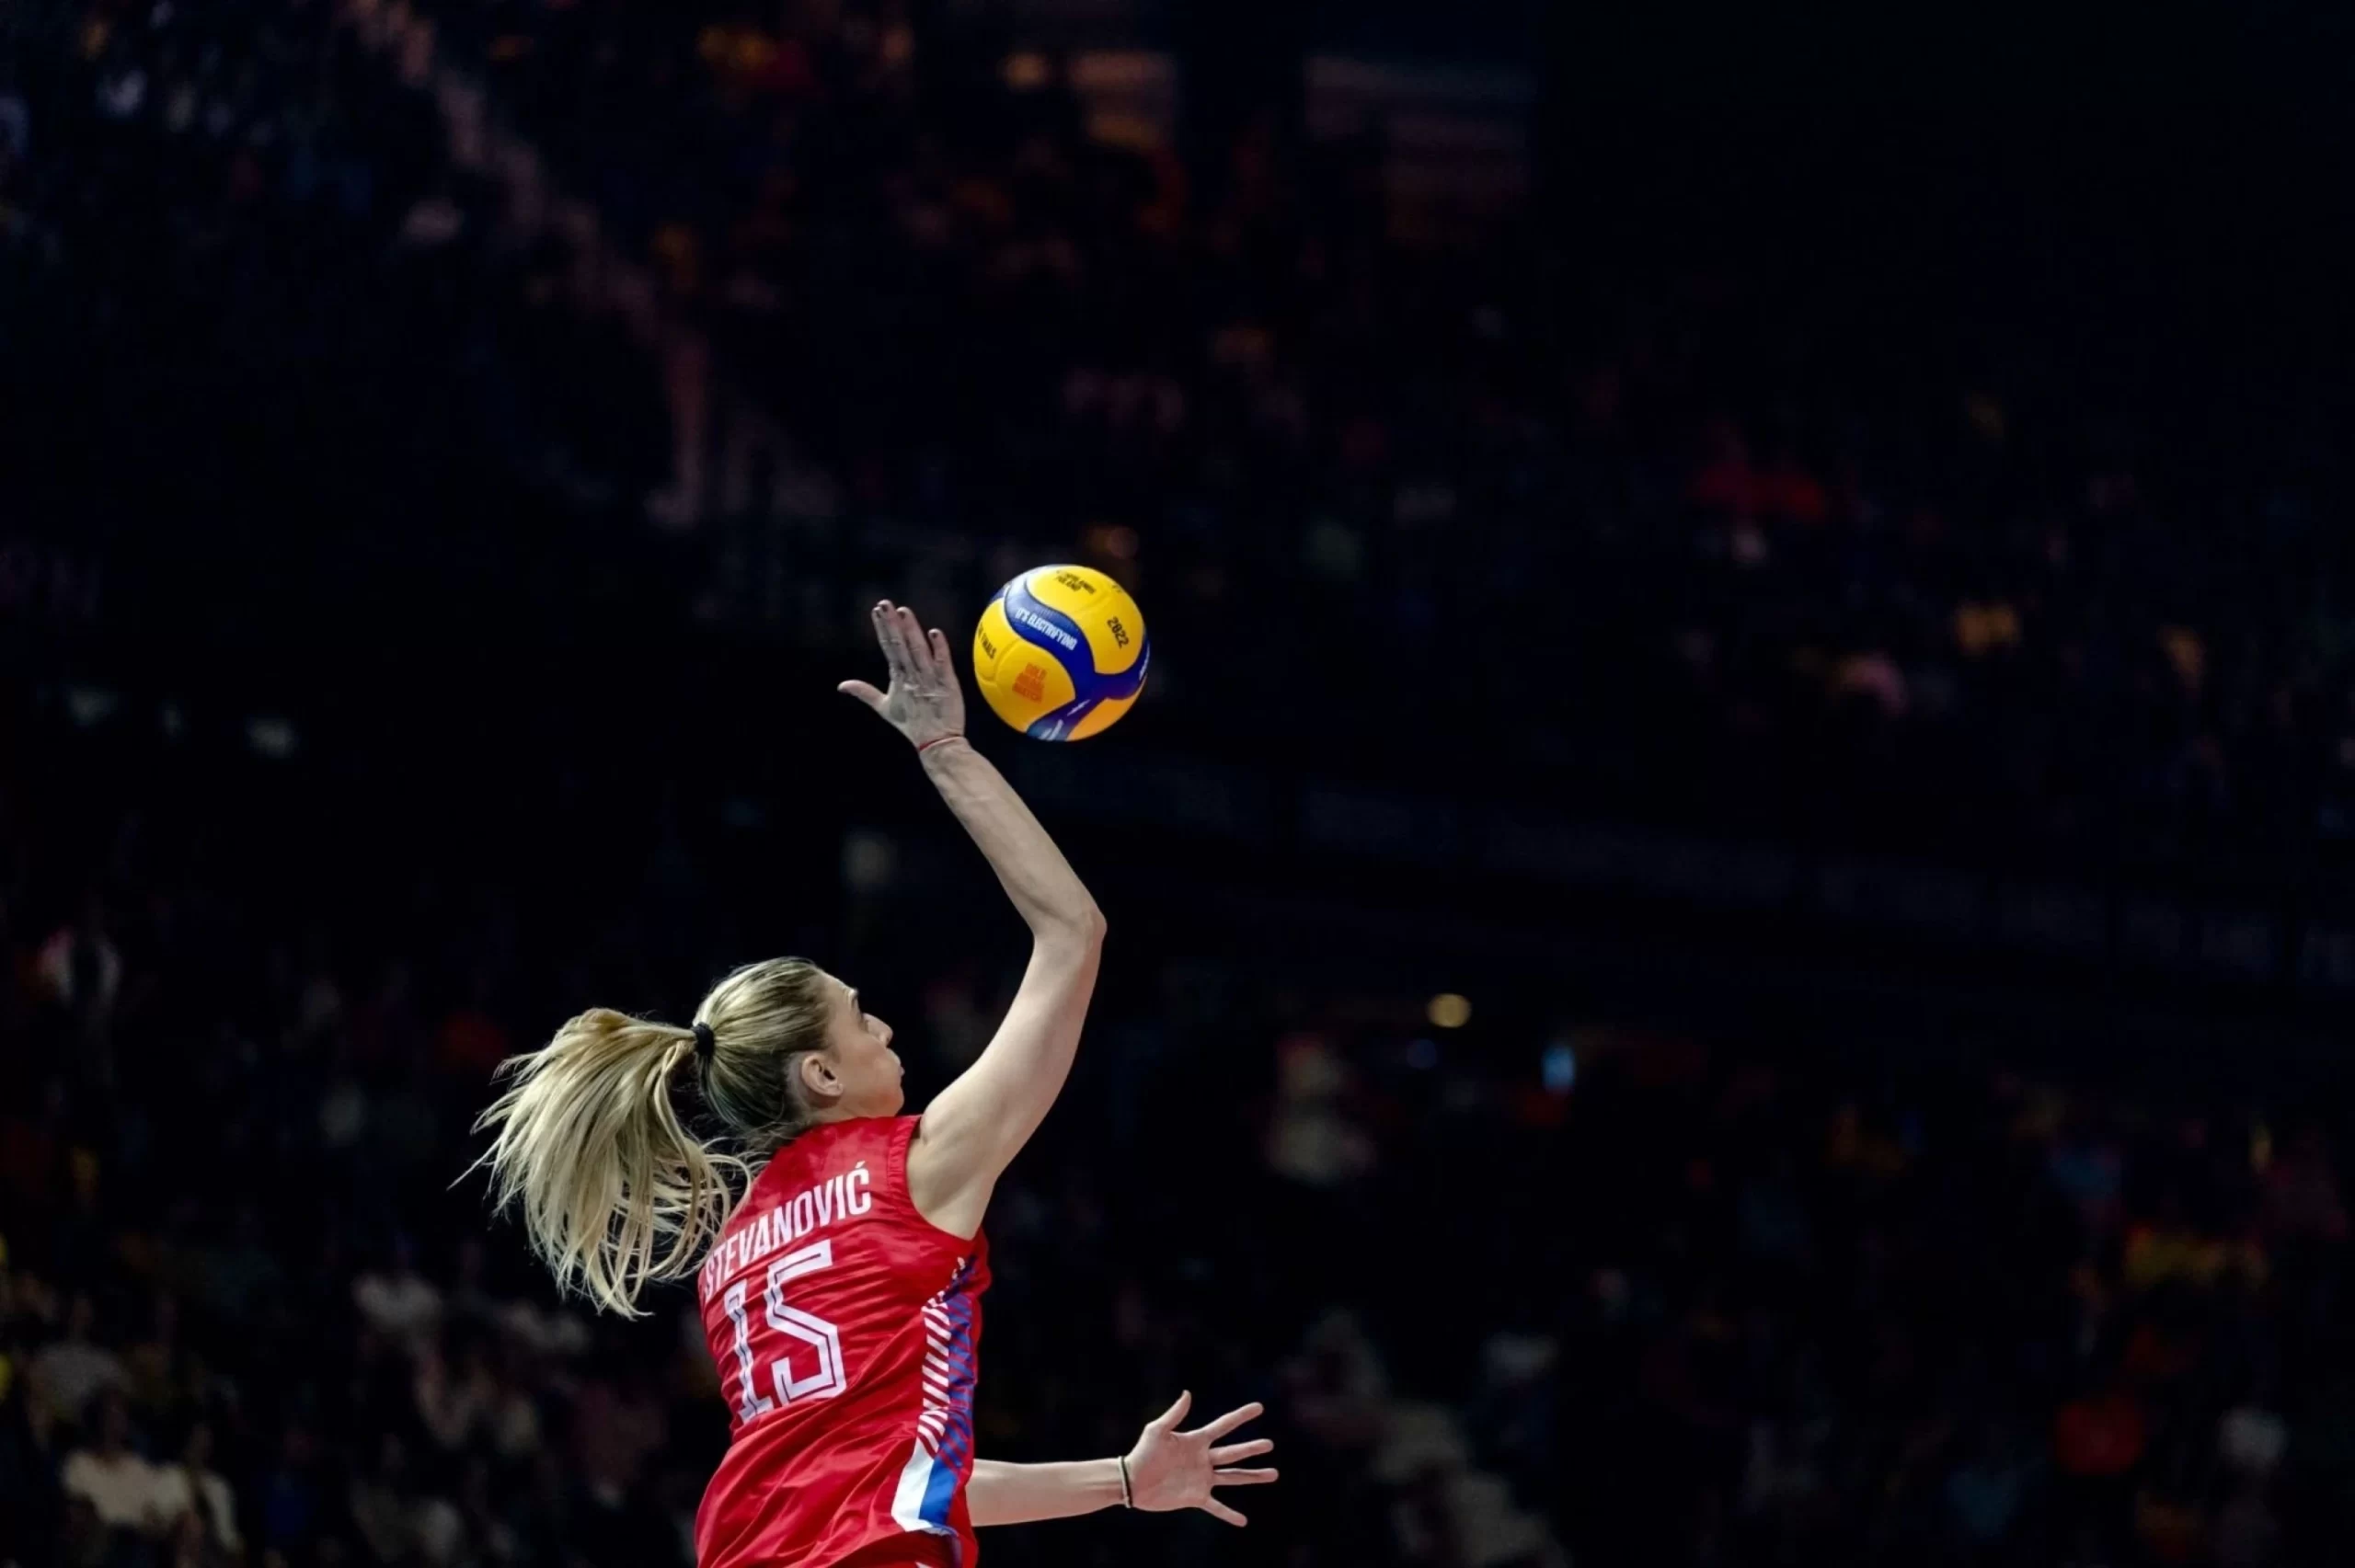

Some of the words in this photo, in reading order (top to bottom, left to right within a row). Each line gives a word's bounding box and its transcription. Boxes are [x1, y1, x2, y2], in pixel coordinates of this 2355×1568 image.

[1107, 616, 1130, 649] 2022
[704, 1162, 872, 1303] STEVANOVIĆ
[723, 1239, 847, 1425] 15
